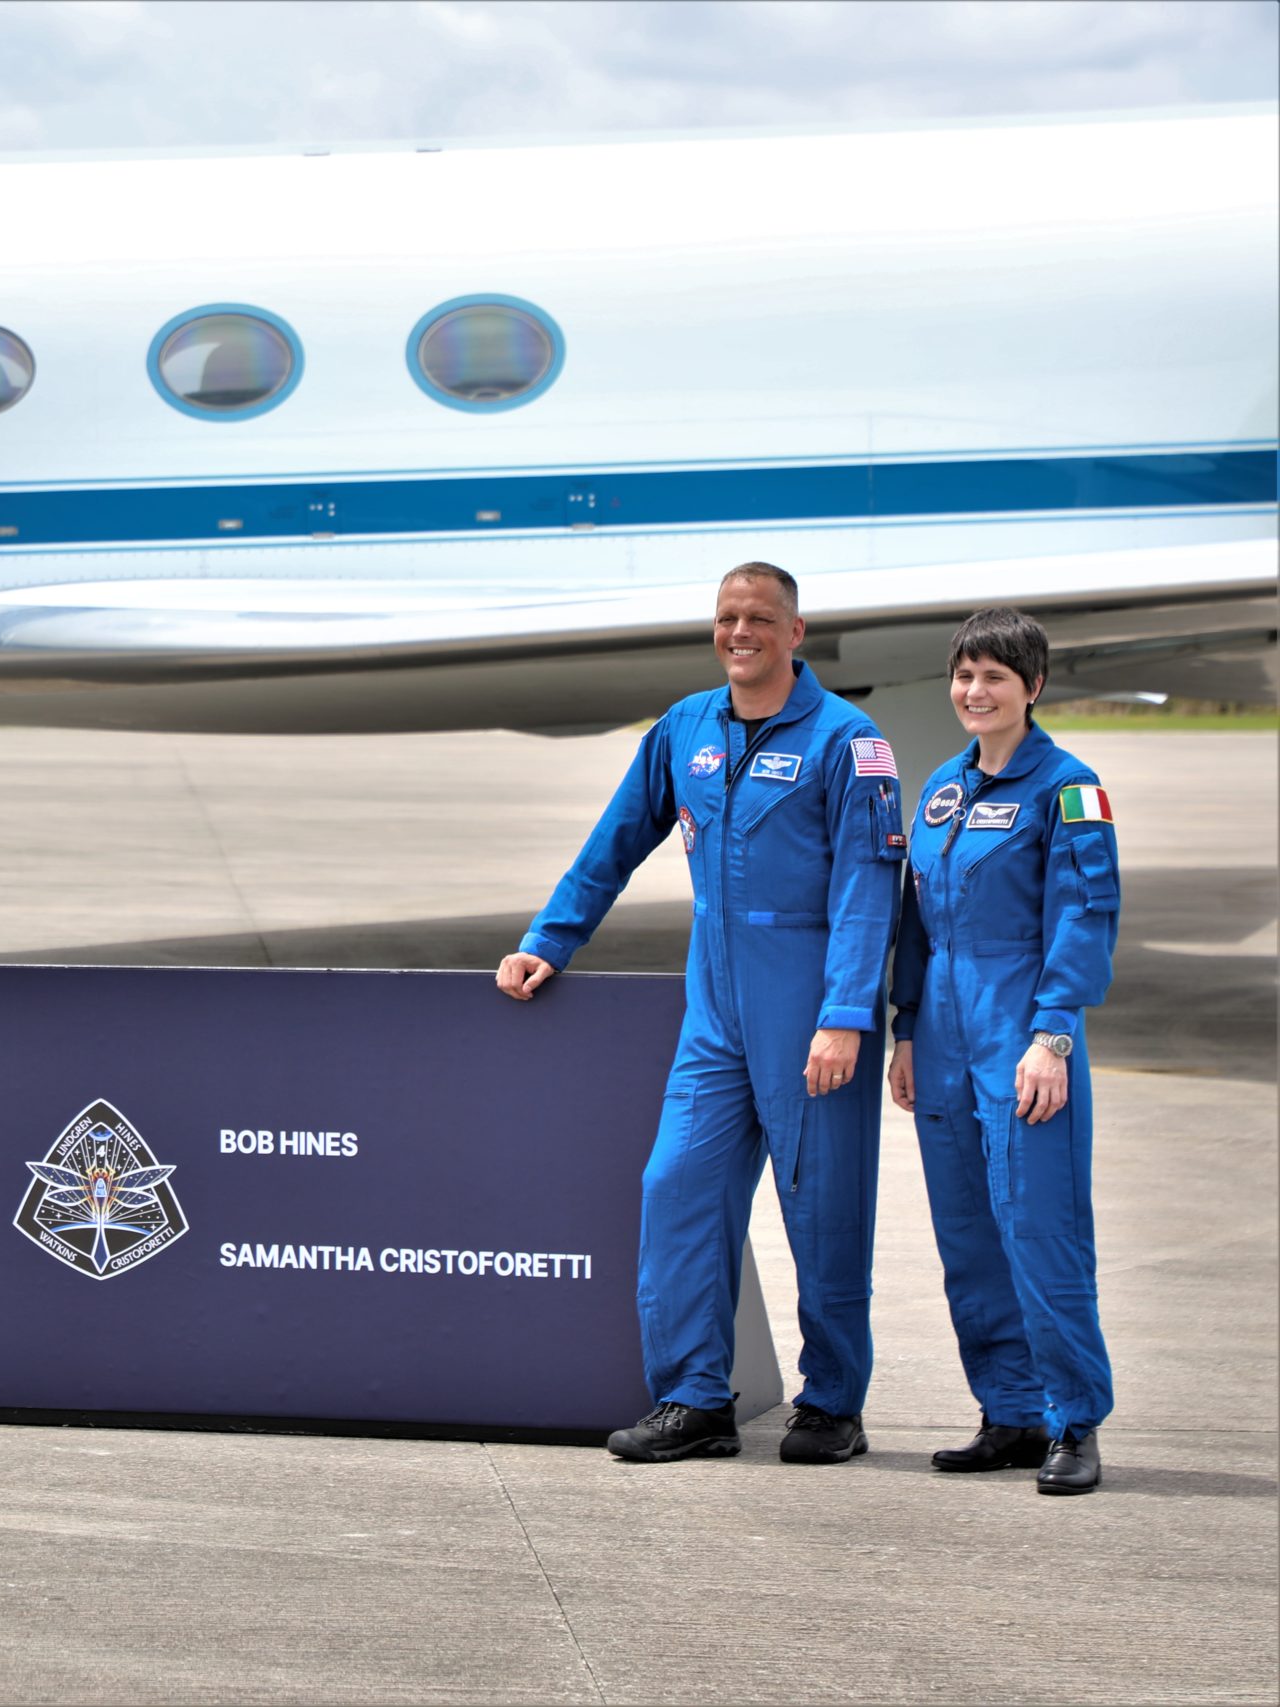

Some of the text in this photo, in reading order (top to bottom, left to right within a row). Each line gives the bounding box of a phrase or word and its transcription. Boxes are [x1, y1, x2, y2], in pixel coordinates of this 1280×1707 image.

[56, 1116, 93, 1156] LINDGREN
[96, 1145, 106, 1157] 4
[114, 1122, 142, 1152] HINES
[220, 1129, 359, 1157] BOB HINES
[39, 1230, 78, 1262] WATKINS
[110, 1226, 175, 1270] CRISTOFORETTI
[219, 1242, 593, 1280] SAMANTHA CRISTOFORETTI
